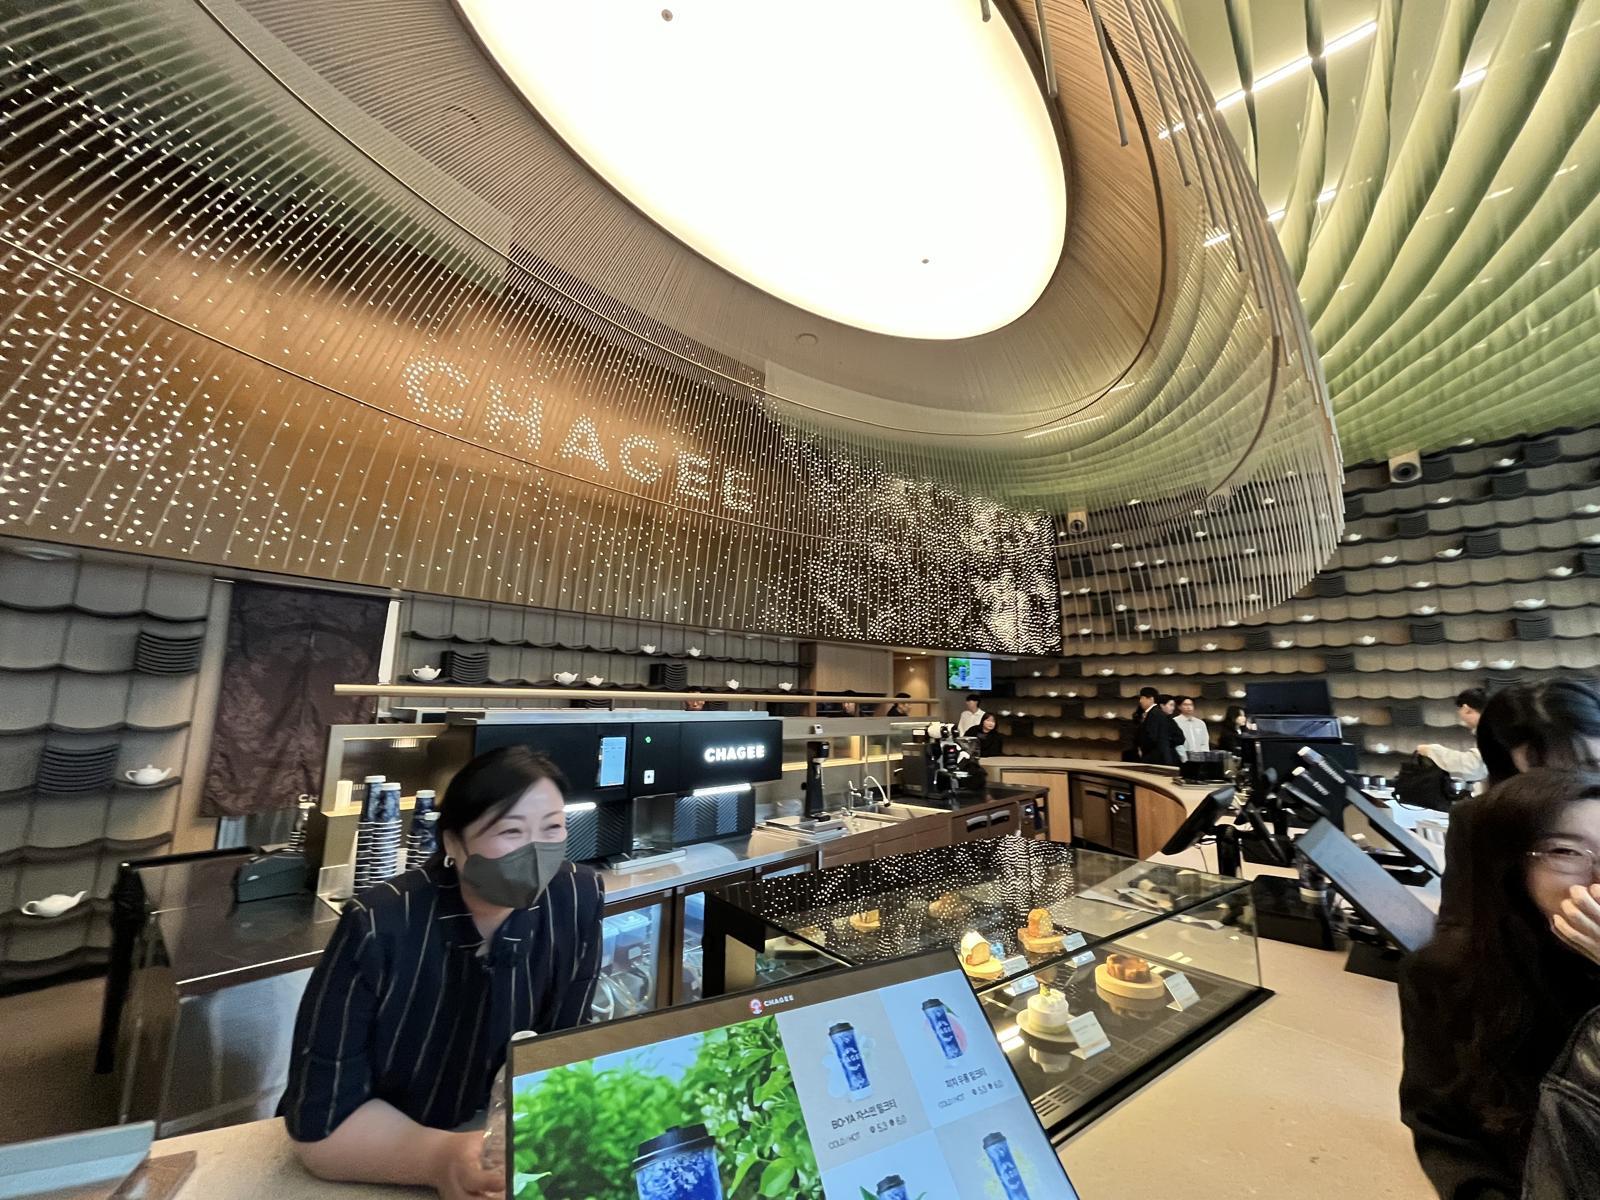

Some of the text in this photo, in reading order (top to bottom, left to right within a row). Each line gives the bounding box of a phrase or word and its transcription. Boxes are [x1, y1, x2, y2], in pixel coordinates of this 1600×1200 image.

[402, 355, 753, 514] CHAGEE
[704, 745, 765, 762] CHAGEE
[763, 994, 794, 1006] CHAGEE
